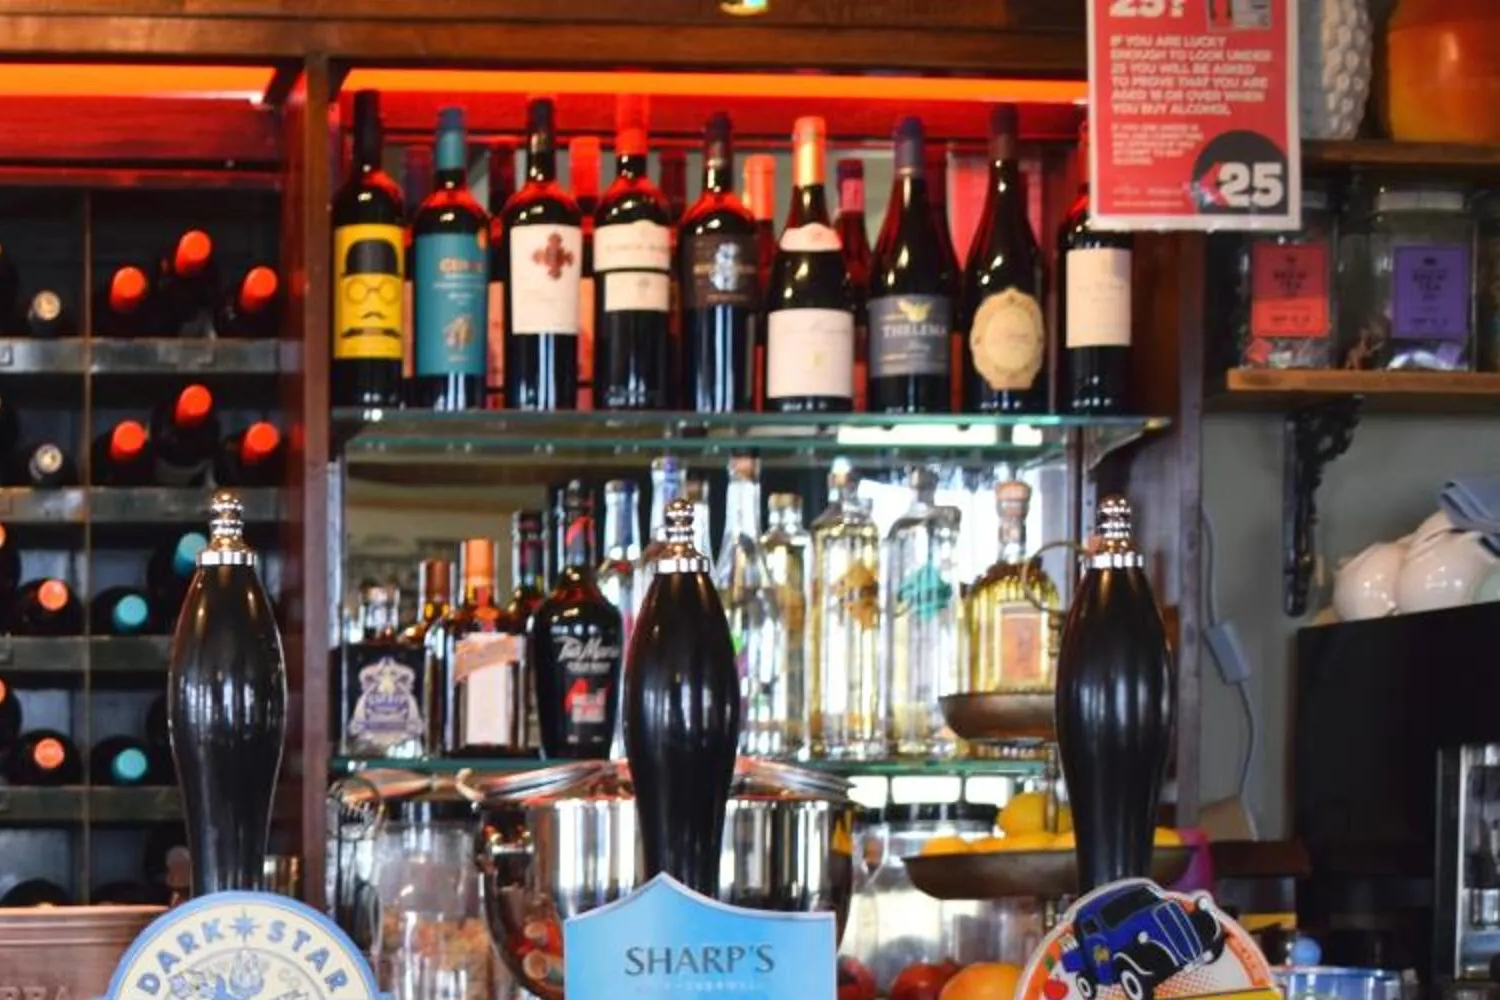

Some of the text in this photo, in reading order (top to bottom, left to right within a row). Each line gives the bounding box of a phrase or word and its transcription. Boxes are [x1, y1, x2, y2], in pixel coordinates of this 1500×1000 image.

[135, 917, 349, 996] DARK STAR
[624, 944, 775, 977] SHARP'S
